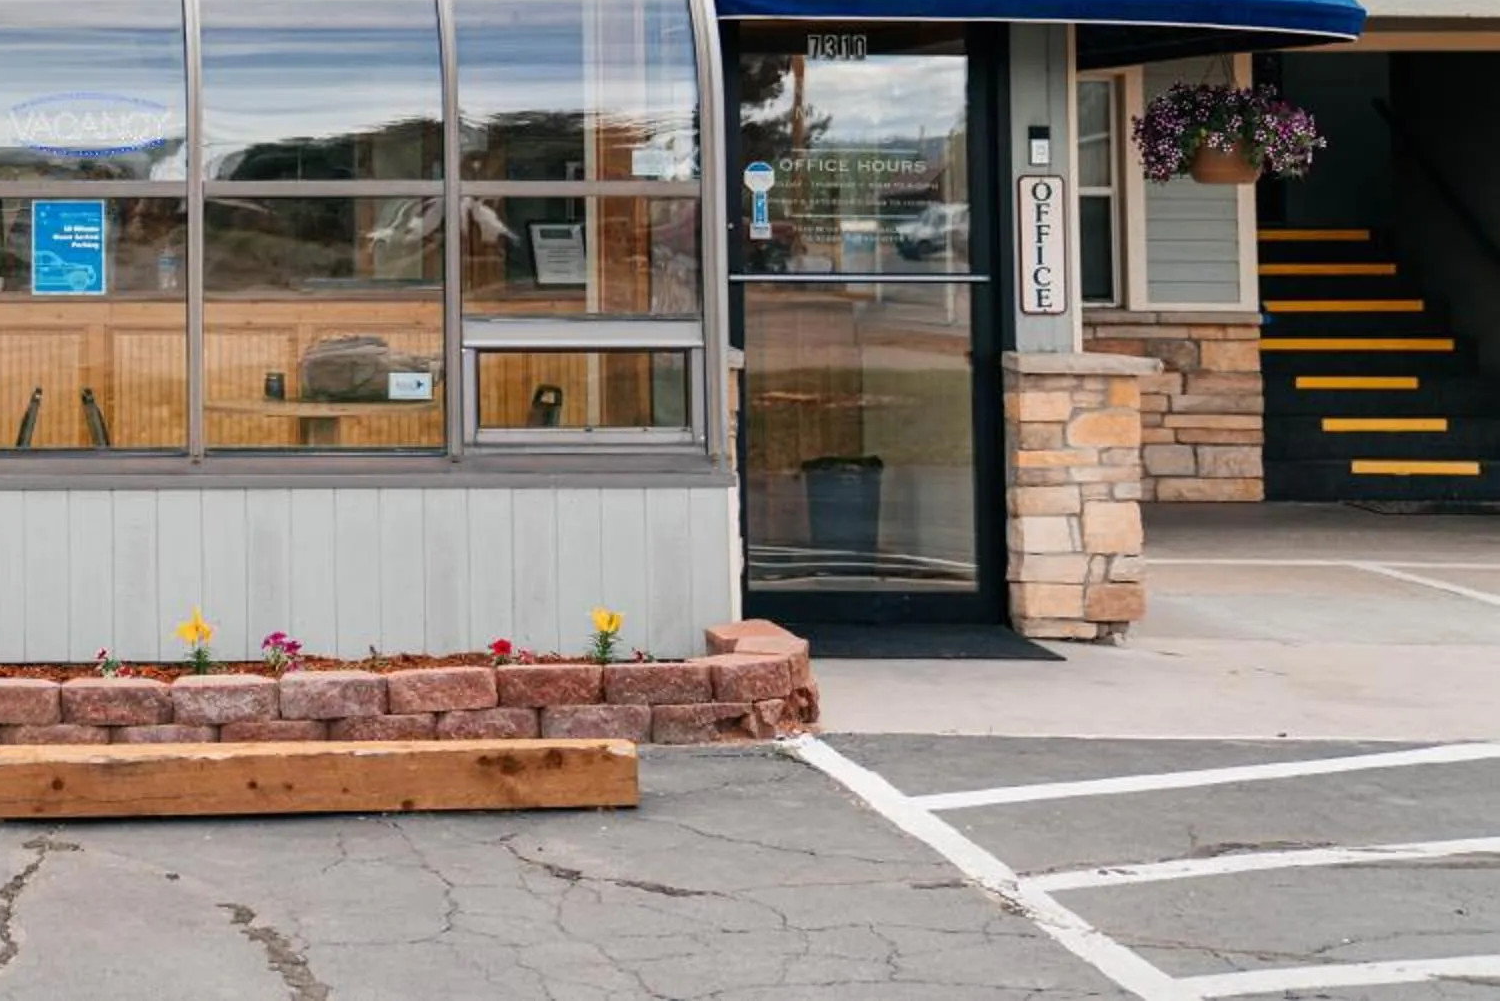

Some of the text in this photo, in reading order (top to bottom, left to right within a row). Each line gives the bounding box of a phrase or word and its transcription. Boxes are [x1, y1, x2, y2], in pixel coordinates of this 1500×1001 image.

[807, 33, 867, 61] 7310
[8, 110, 170, 141] VACANCY
[779, 158, 928, 174] OFFICE HOURS
[1031, 181, 1053, 308] OFFICE
